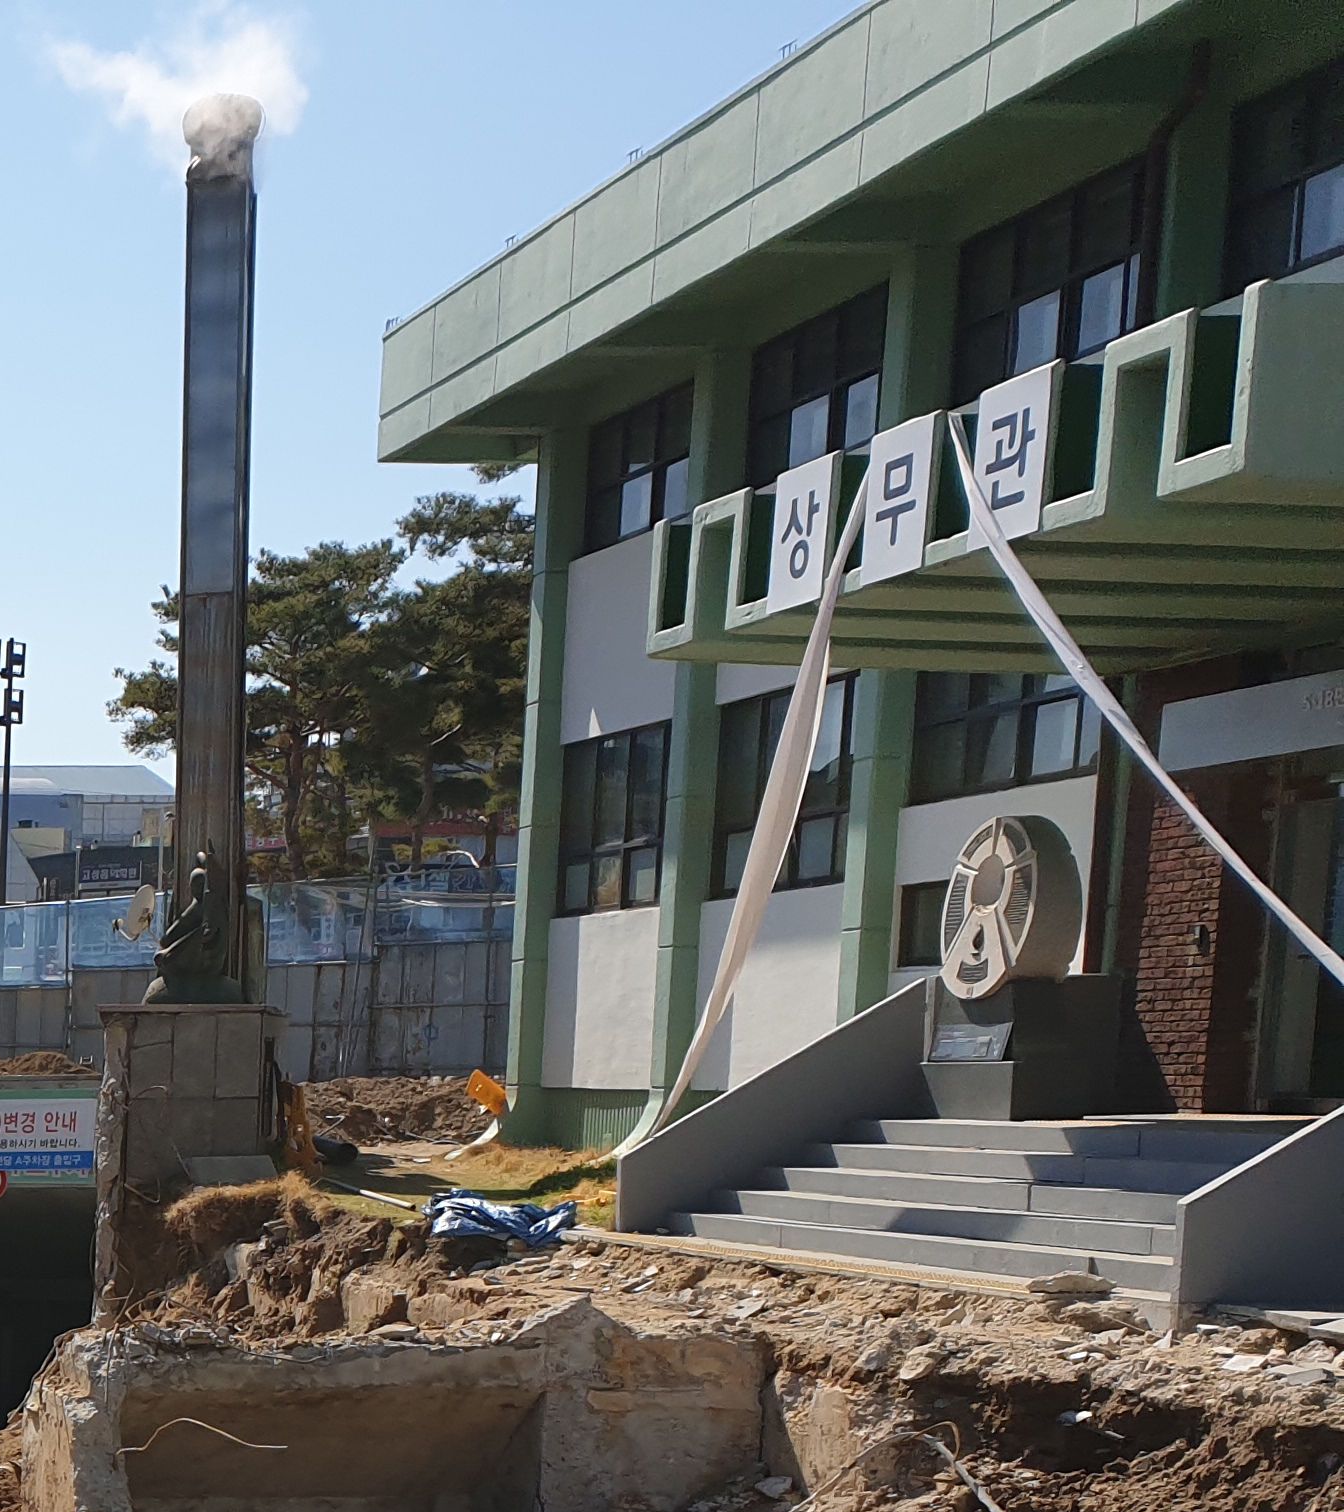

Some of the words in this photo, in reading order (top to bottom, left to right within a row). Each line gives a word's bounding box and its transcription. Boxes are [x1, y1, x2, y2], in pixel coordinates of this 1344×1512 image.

[781, 406, 1036, 579] 상무관
[44, 1111, 77, 1133] 안내
[39, 1138, 81, 1148] 바랍니다.
[14, 1154, 51, 1166] A주차장
[53, 1154, 81, 1166] 출입구
